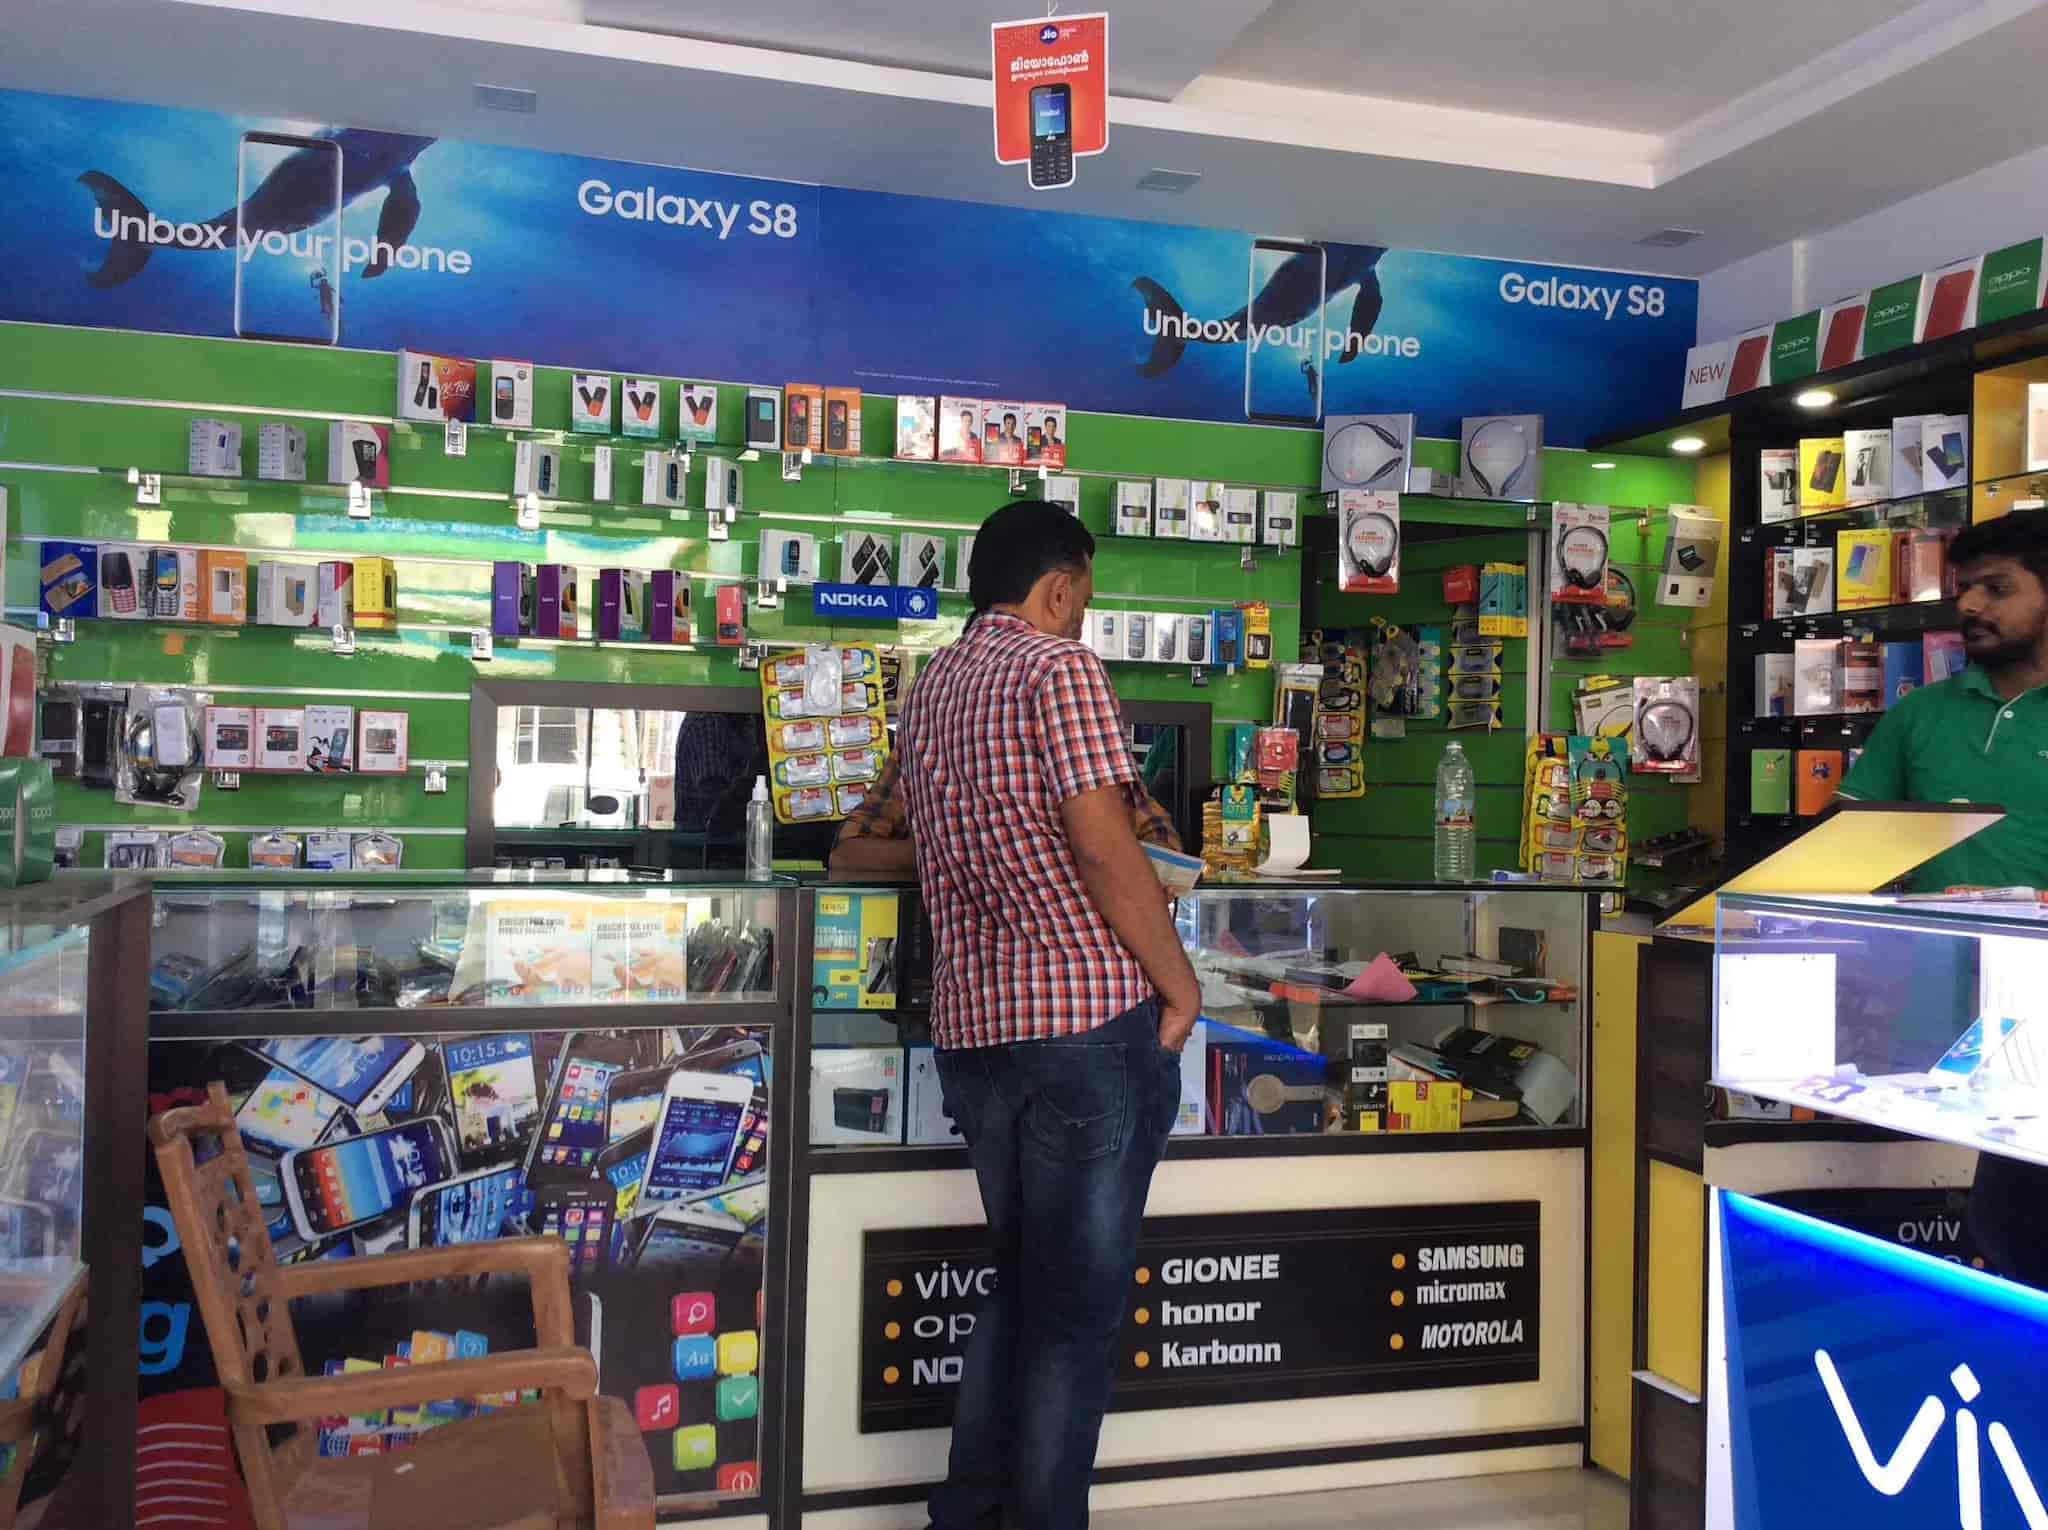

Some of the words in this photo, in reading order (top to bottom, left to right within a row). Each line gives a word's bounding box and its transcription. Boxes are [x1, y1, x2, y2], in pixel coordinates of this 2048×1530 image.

[1041, 27, 1057, 40] Jio
[578, 179, 741, 240] Galaxy
[747, 200, 798, 239] S8
[94, 206, 226, 251] Unbox
[237, 227, 333, 264] your
[343, 236, 473, 276] phone
[1501, 272, 1622, 320] Galaxy
[1628, 285, 1666, 318] S8
[1143, 309, 1240, 344] Unbox
[1247, 322, 1316, 352] your
[1325, 327, 1421, 359] phone
[1689, 362, 1726, 385] NEW
[820, 592, 889, 608] NOKIA
[453, 1042, 497, 1065] 10:15
[1161, 1254, 1281, 1285] GIONEE
[1417, 1244, 1525, 1272] SAMSUNG
[1416, 1279, 1506, 1305] micromax
[912, 1313, 977, 1344] op
[1161, 1301, 1262, 1326] honor
[1421, 1319, 1524, 1349] MOTOROLA
[1161, 1339, 1282, 1369] Karbonn
